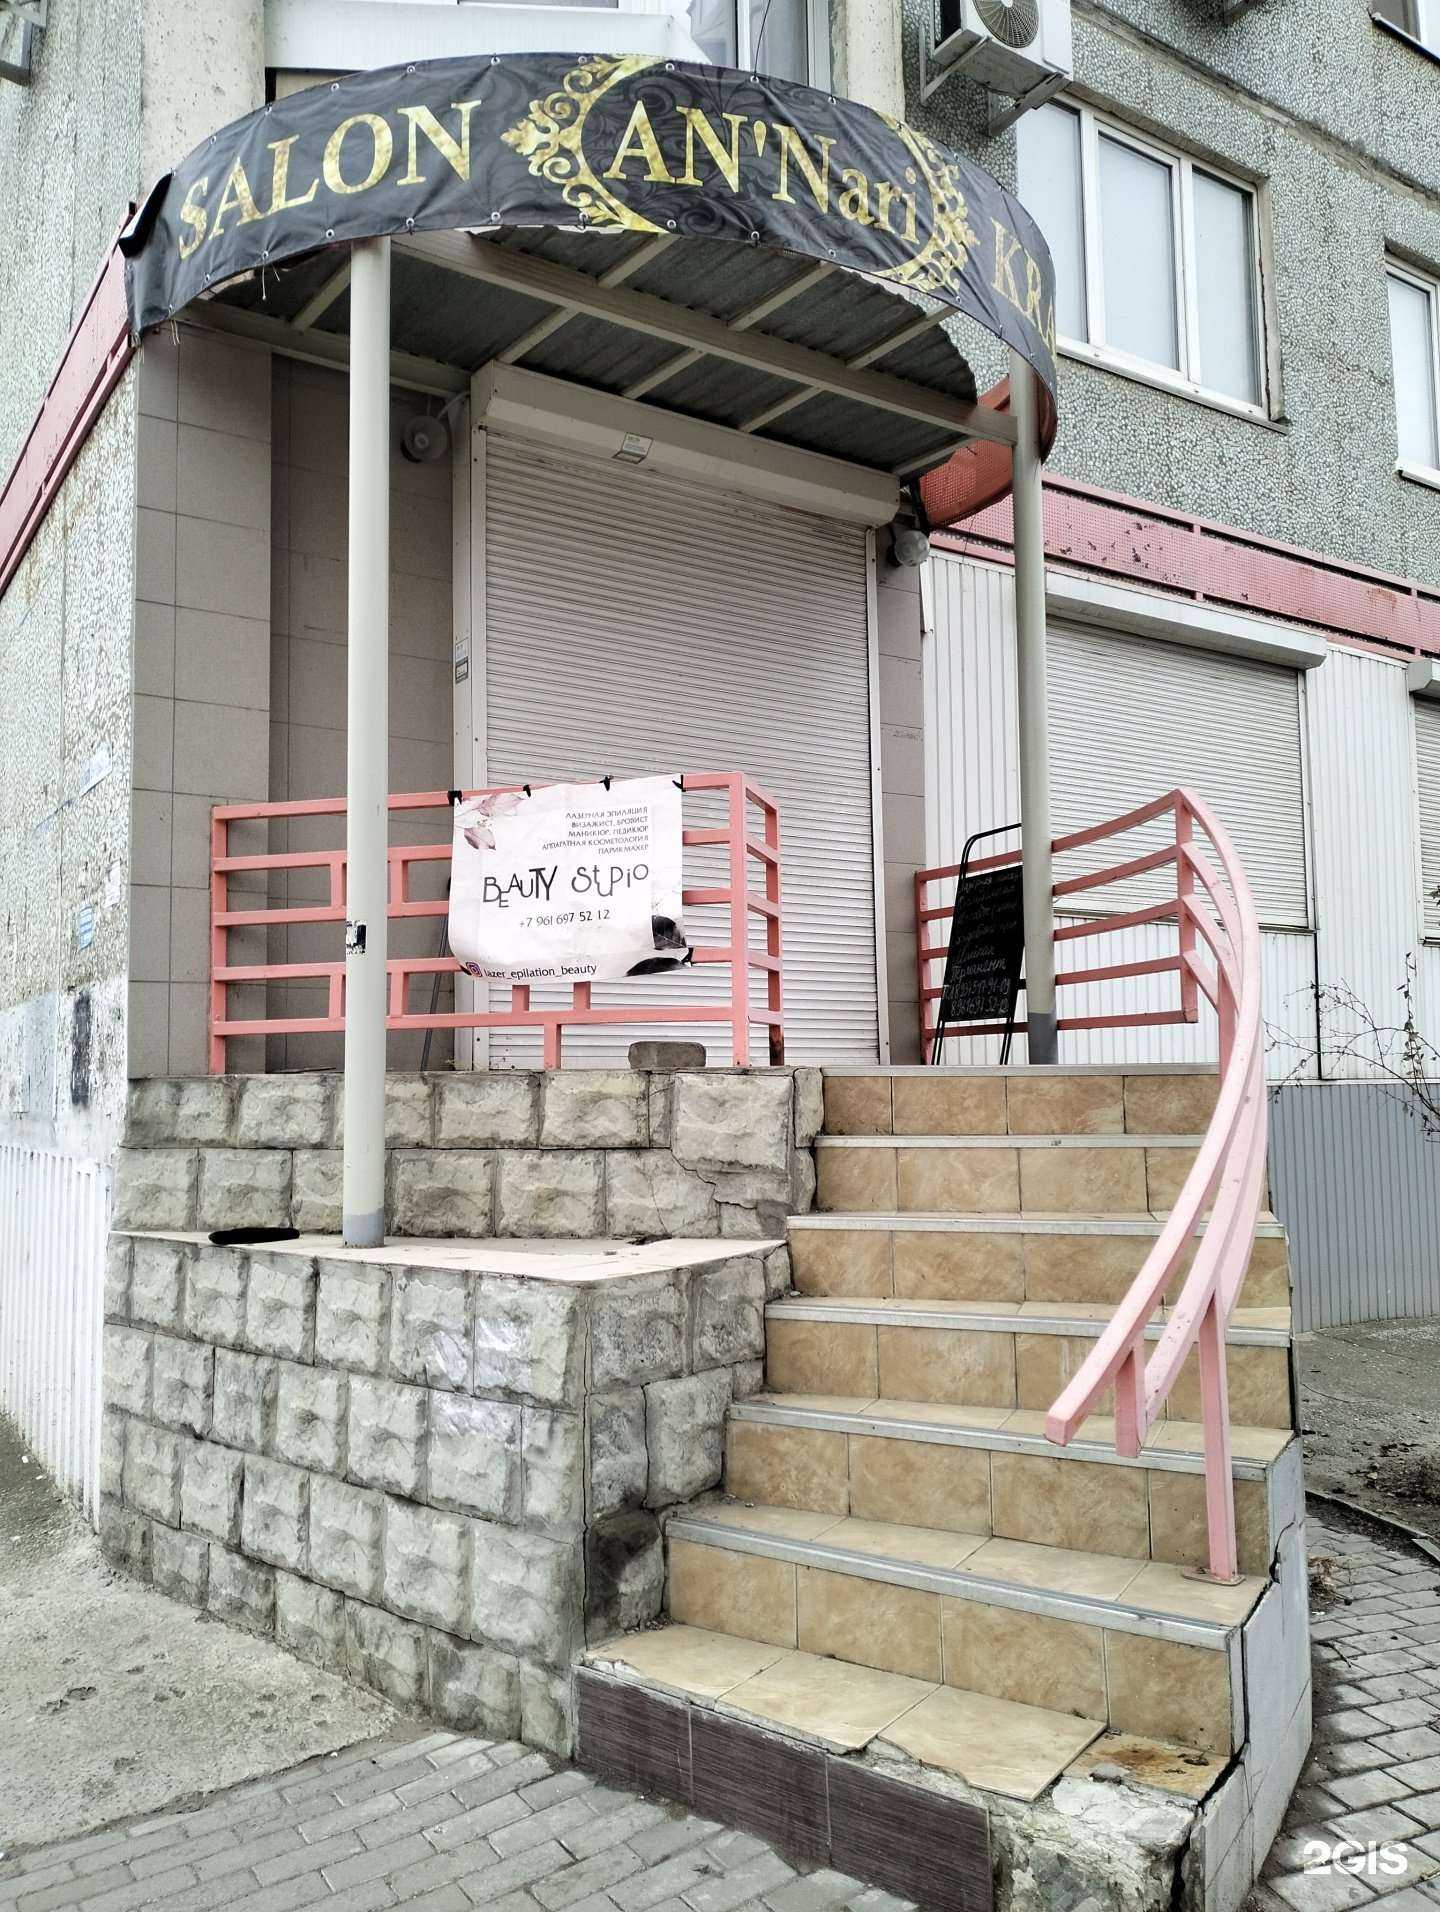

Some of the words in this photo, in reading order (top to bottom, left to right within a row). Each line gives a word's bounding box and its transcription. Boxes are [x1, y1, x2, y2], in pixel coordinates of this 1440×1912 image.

[177, 100, 482, 260] SALON
[603, 100, 919, 244] AN'Nari
[565, 811, 605, 820] ЛАЗЕРНАЯ
[606, 806, 648, 818] ЭПИЛЯЦИЯ
[612, 825, 649, 835] ПЕДИКЮР
[542, 839, 587, 851] АППАРАТНАЯ
[588, 835, 649, 847] КОСМЕТОЛОГИЯ
[598, 843, 649, 855] ПАРИКМАХЕР
[482, 865, 558, 908] BEAUTY
[519, 917, 533, 928] +7
[536, 915, 553, 927] 961
[556, 913, 575, 925] 697
[579, 910, 593, 922] 52
[598, 909, 610, 921] 12
